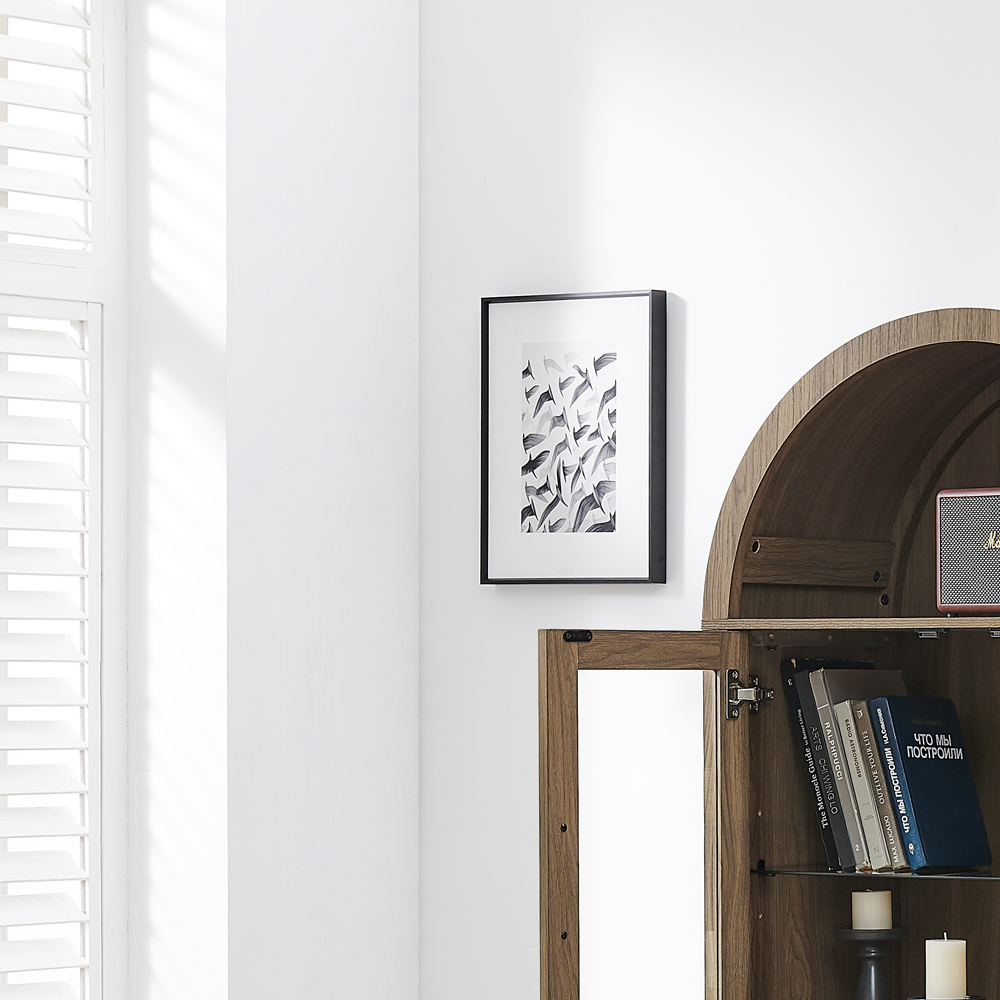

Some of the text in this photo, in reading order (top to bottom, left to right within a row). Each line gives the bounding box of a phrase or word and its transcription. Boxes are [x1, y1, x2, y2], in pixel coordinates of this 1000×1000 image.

[844, 718, 862, 778] RADIO ASTRONOMER
[862, 729, 871, 746] LIFE
[913, 733, 952, 746] ЧТО МЫ
[805, 747, 816, 774] Guide
[867, 747, 876, 769] YOUR
[906, 745, 964, 760] ПОСТРОИЛИ
[810, 726, 839, 815] ARTS CHI WING LO
[884, 747, 902, 798] ПОСТРОИЛИ
[811, 774, 825, 811] Monocle
[872, 769, 885, 804] OUTLIVE
[897, 799, 906, 814] МЫ
[820, 811, 829, 829] The
[901, 815, 910, 833] ЧТО
